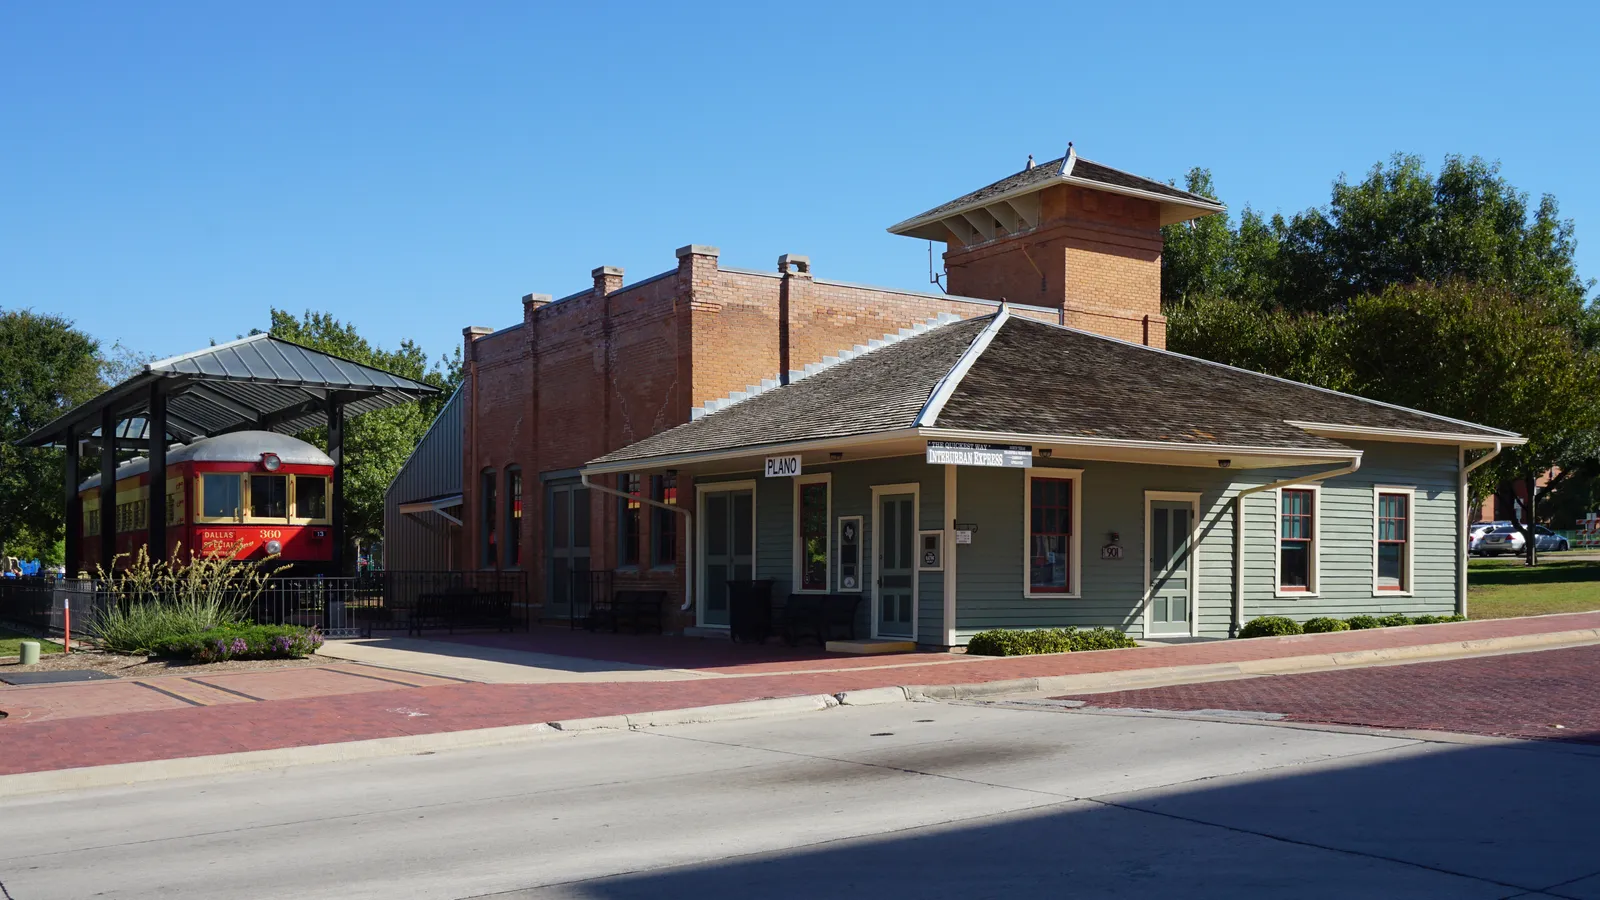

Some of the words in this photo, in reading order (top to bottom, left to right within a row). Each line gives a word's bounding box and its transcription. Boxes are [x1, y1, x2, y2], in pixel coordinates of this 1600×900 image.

[932, 441, 945, 449] THE
[945, 442, 974, 450] QUICKEST
[975, 443, 988, 451] WAY
[929, 449, 973, 464] INTERURBAN
[973, 451, 1003, 467] EXPRESS
[767, 457, 797, 475] PLANO
[204, 531, 234, 539] DALLAS
[259, 529, 281, 539] 360
[1106, 547, 1119, 558] 901
